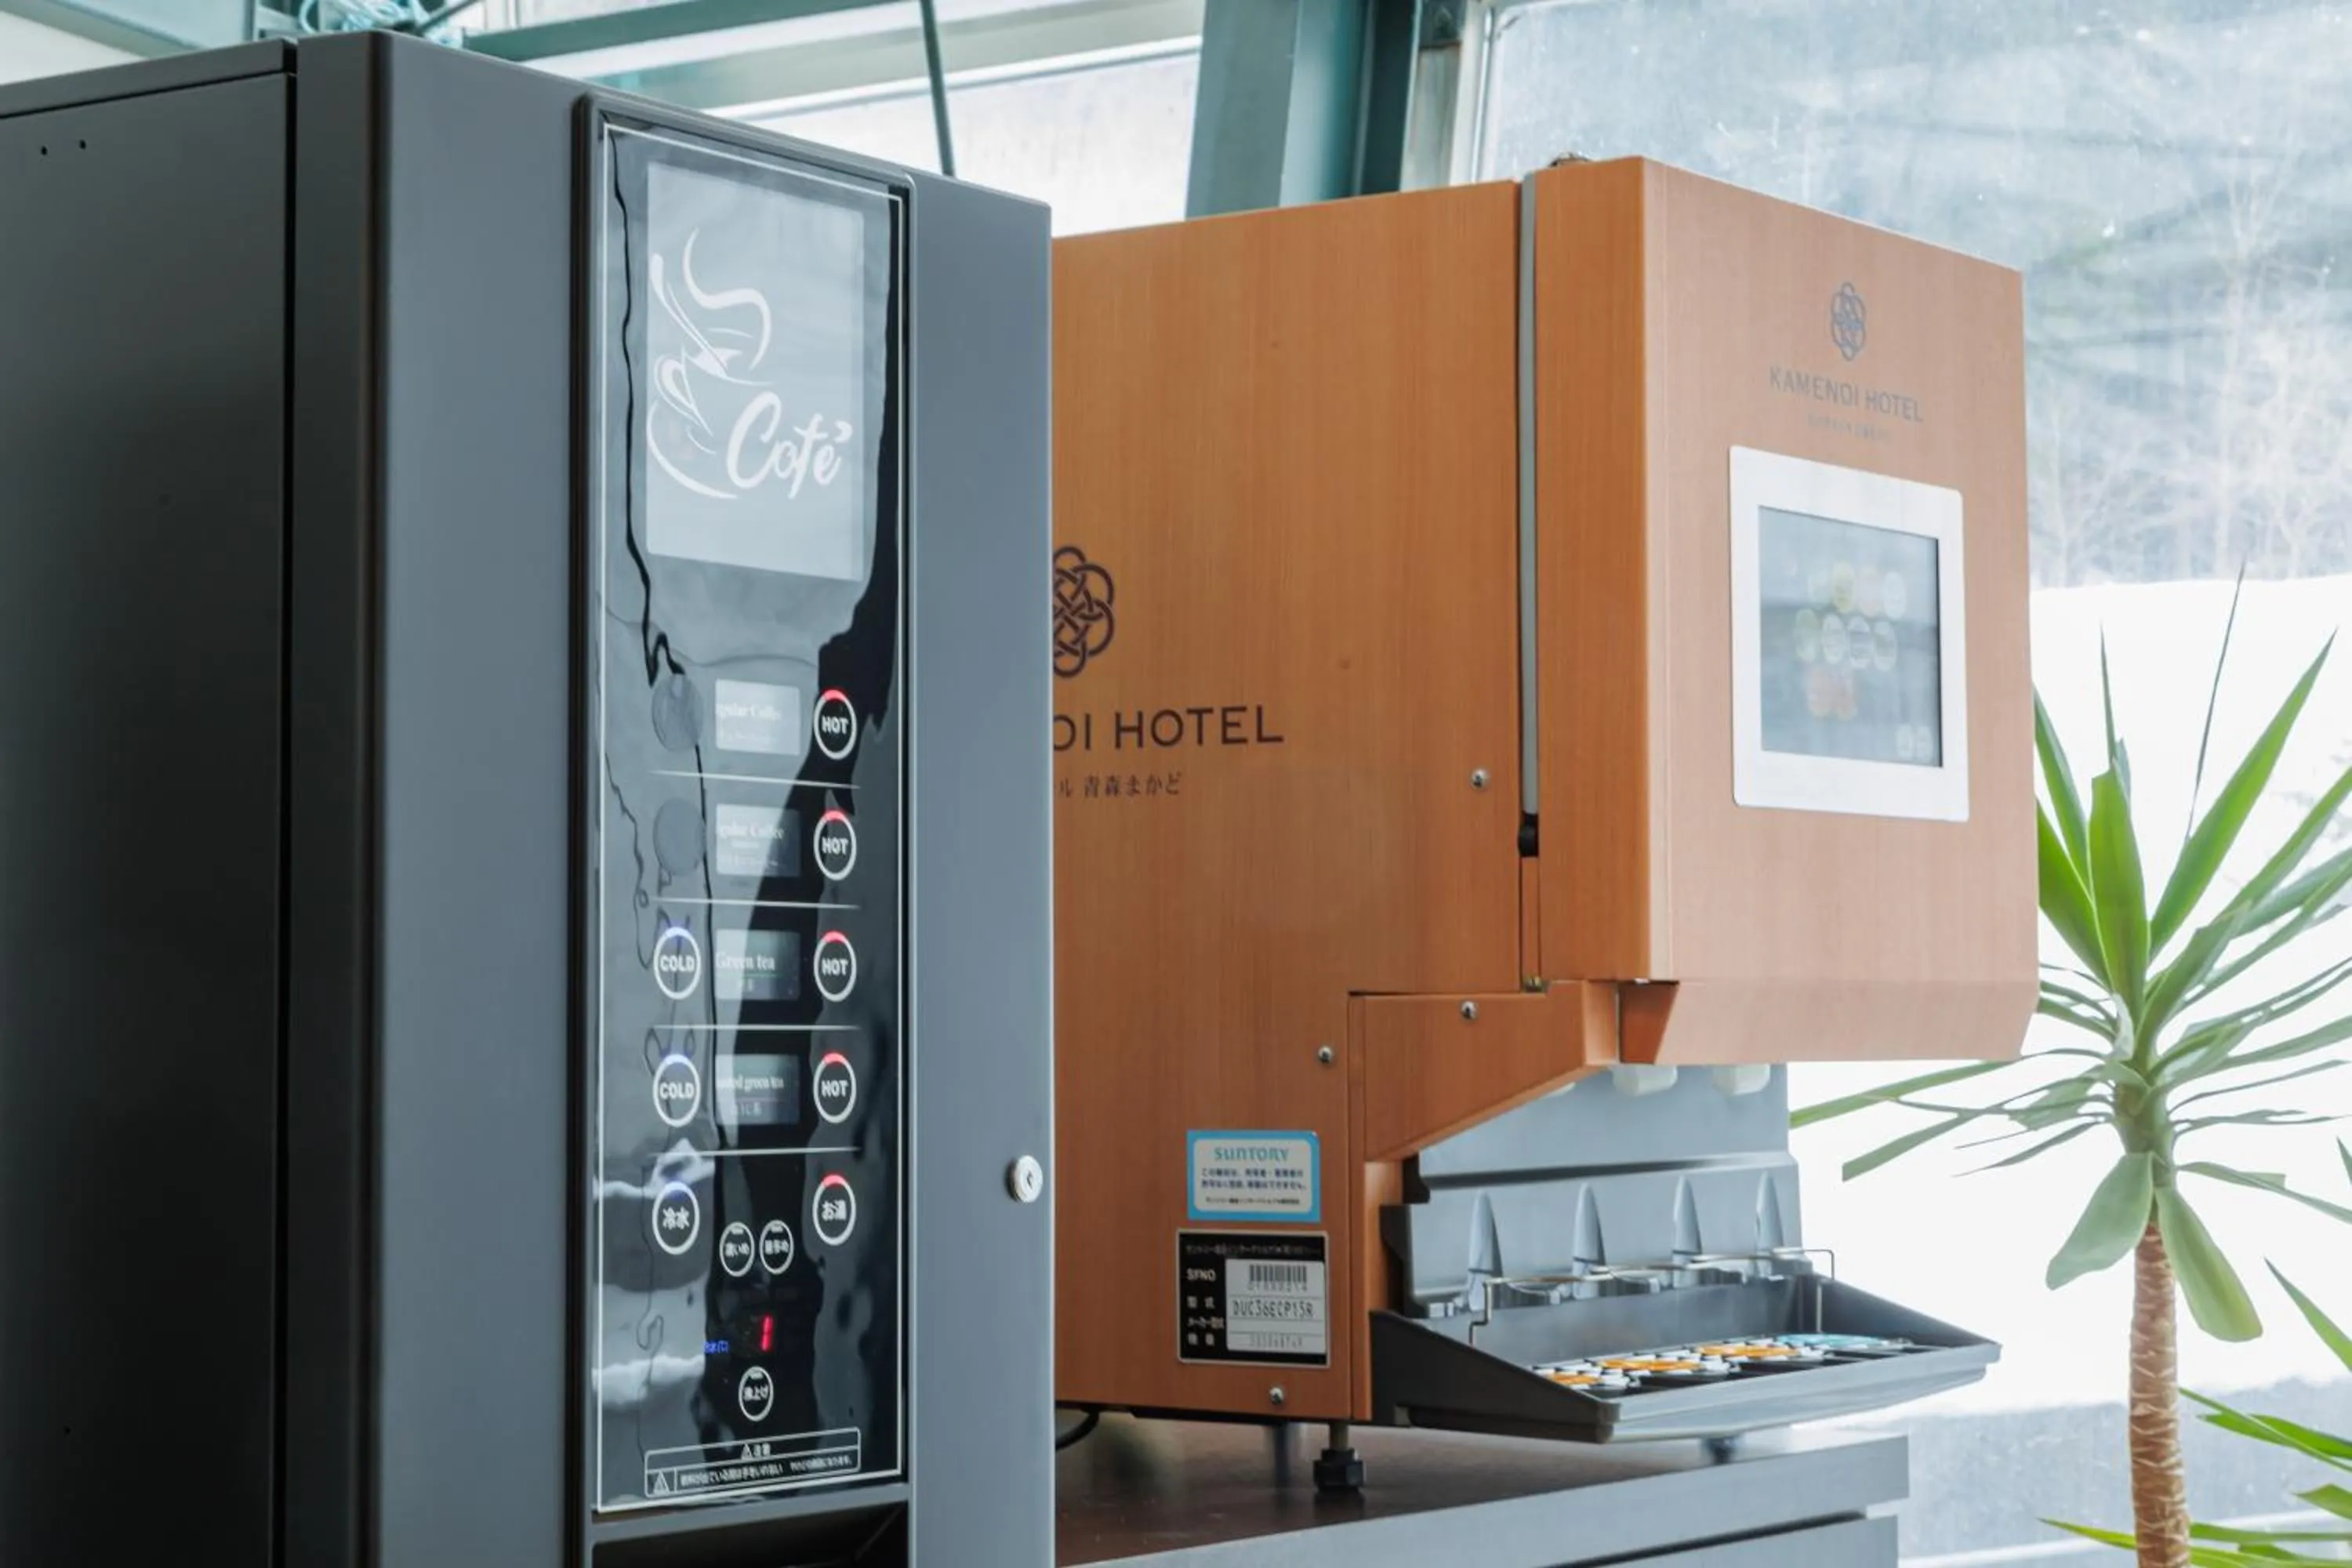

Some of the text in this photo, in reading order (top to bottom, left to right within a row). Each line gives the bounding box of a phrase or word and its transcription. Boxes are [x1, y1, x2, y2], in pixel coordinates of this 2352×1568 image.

[1769, 365, 1924, 422] KAMENOI HOTEL
[822, 716, 849, 735] HOT
[1115, 705, 1284, 750] HOTEL
[1084, 771, 1182, 798] 青森まかど
[822, 837, 849, 855] HOT
[659, 954, 695, 972] COLD
[716, 951, 775, 971] Green tea
[822, 958, 849, 977] HOT
[659, 1081, 695, 1099] COLD
[822, 1079, 849, 1098] HOT
[662, 1206, 690, 1229] 冷水
[761, 1316, 774, 1352] 1
